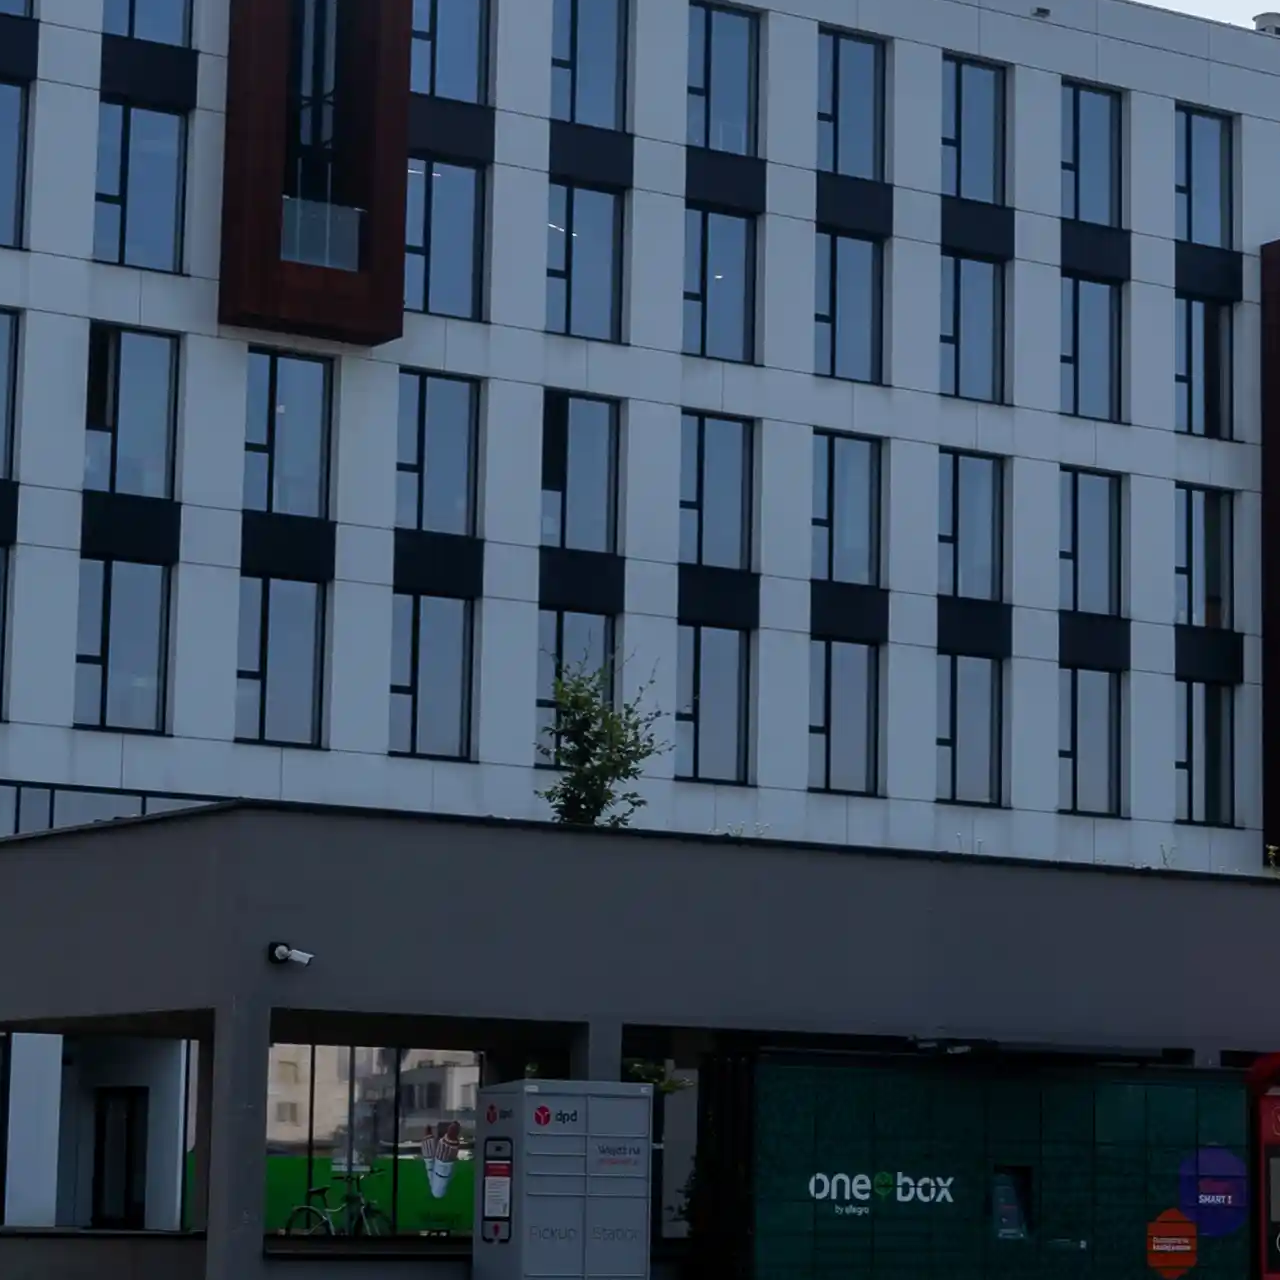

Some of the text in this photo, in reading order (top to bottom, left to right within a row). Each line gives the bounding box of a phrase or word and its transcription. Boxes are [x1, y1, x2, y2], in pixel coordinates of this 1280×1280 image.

[555, 1110, 578, 1124] dpd
[809, 1172, 955, 1203] one box
